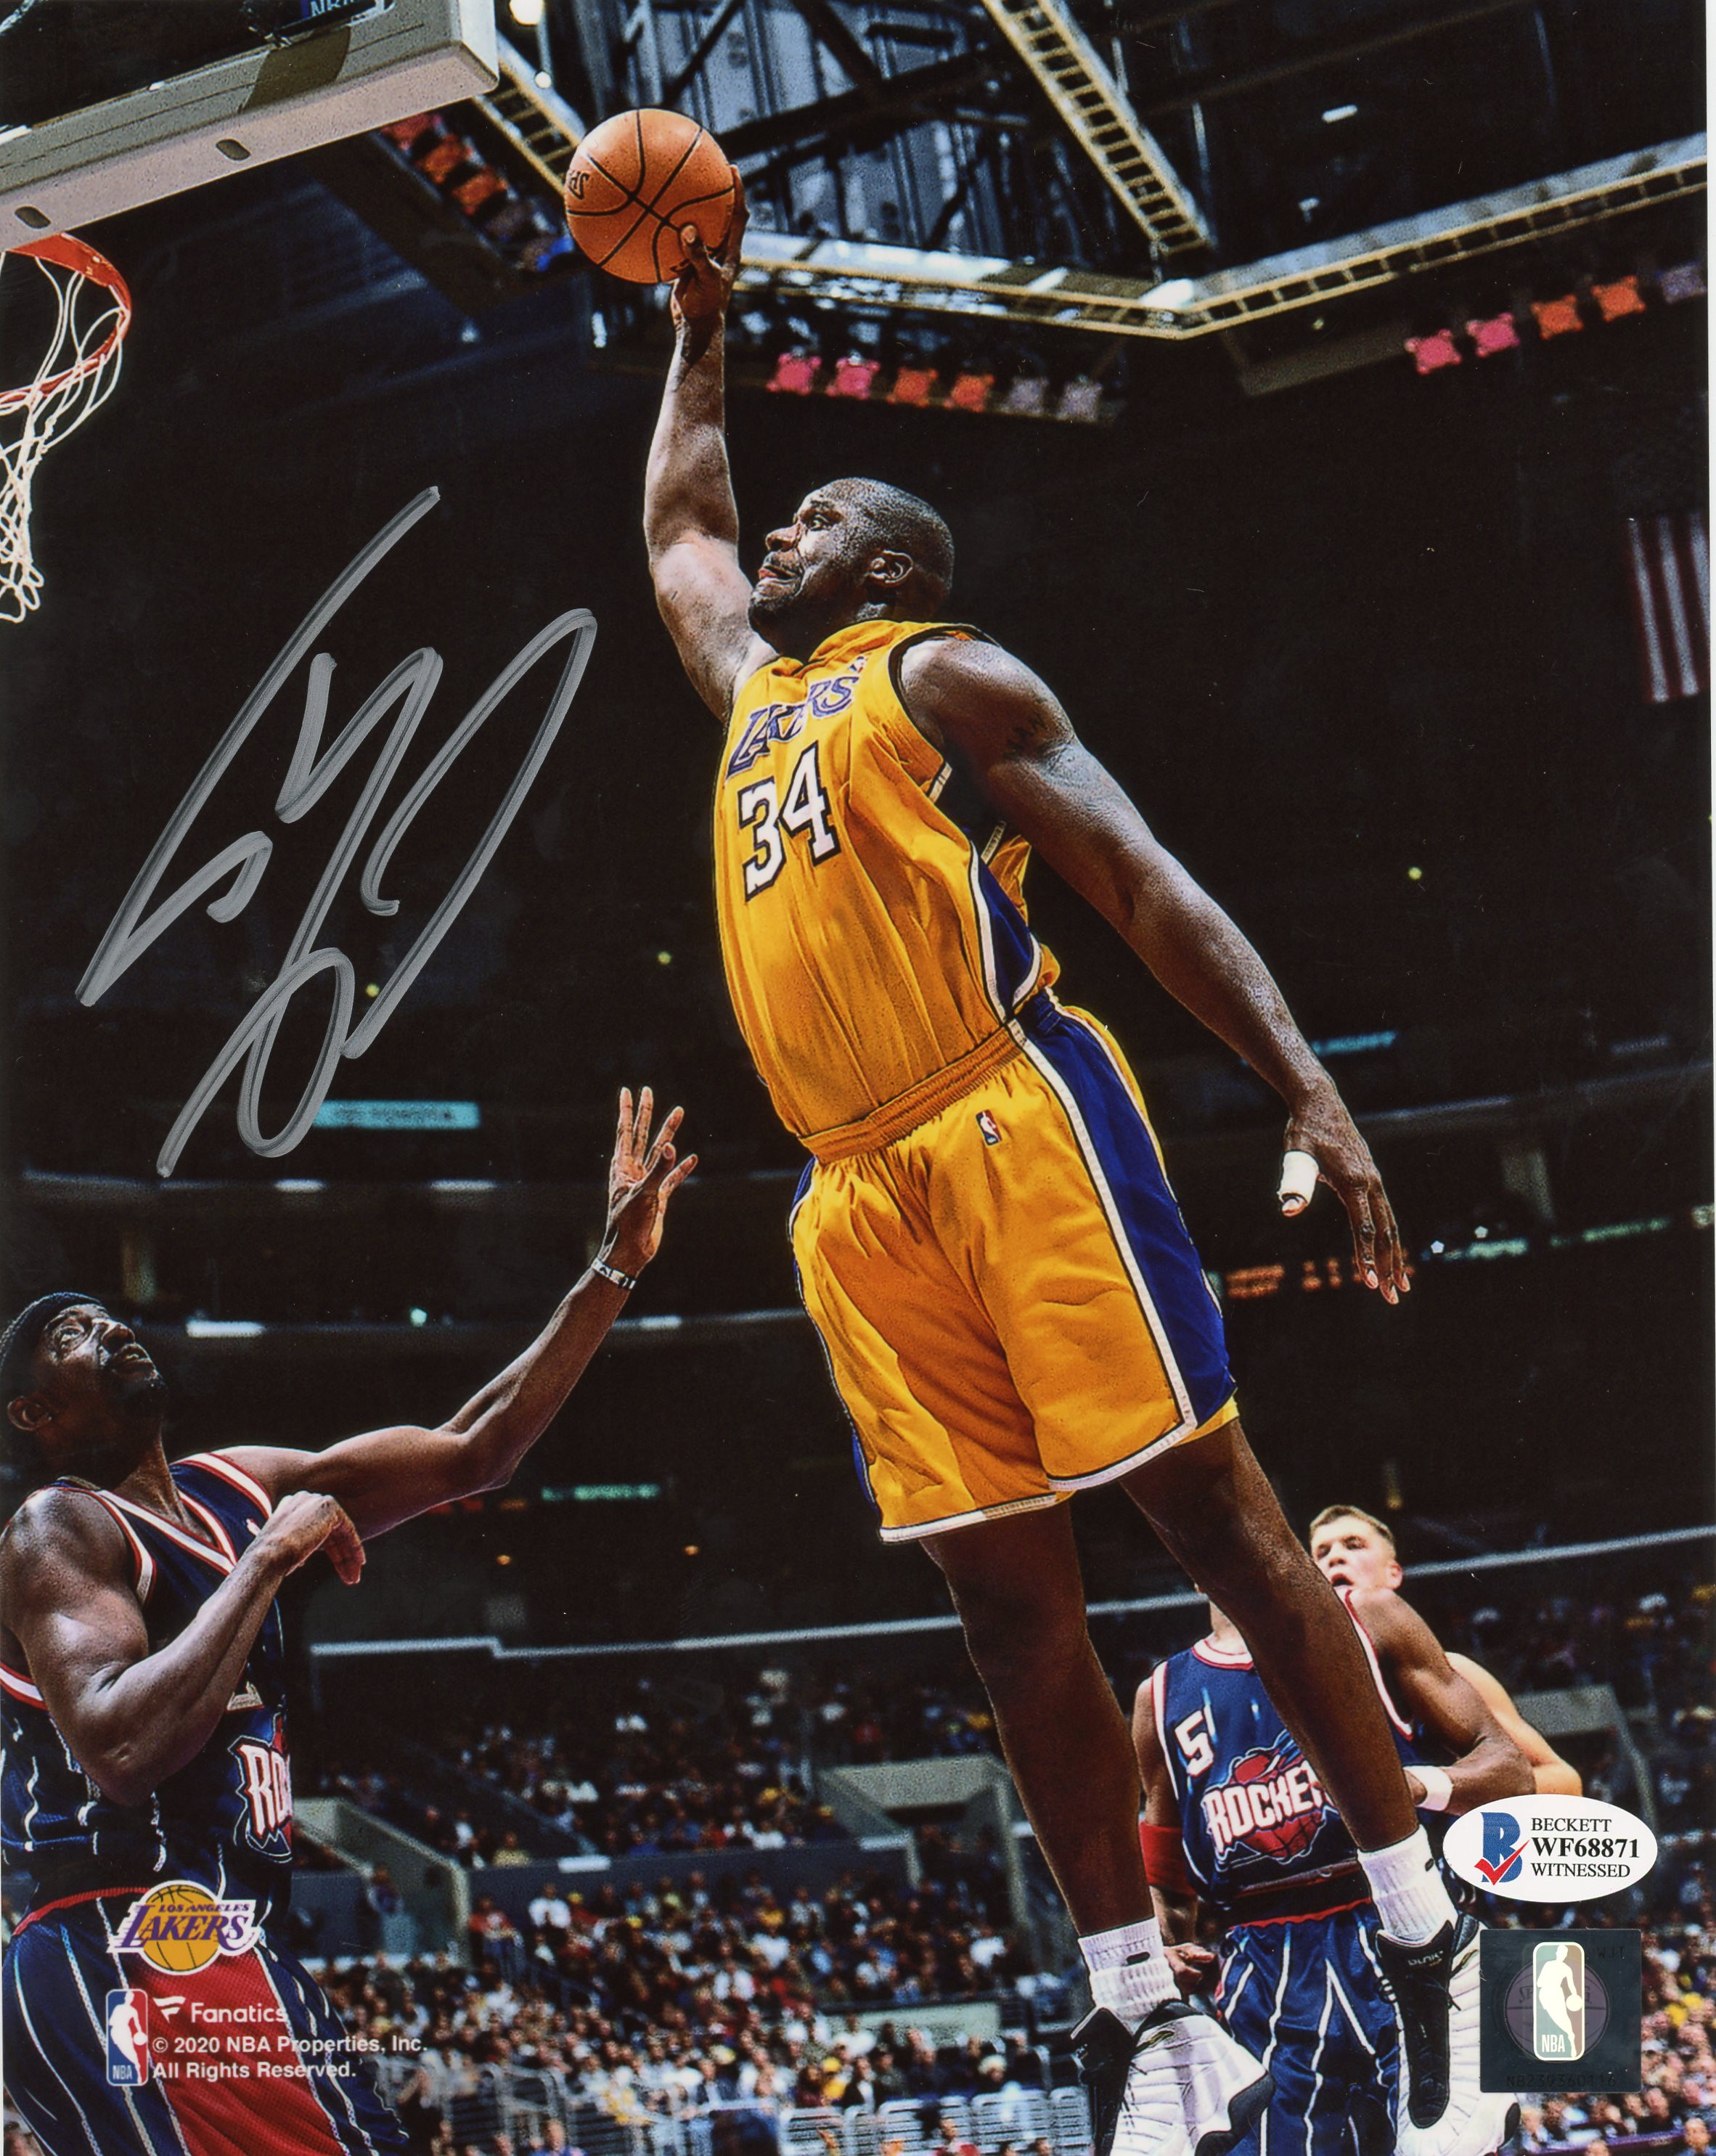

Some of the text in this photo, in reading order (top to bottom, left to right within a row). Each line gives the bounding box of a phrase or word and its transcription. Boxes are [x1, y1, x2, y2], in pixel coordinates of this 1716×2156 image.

[738, 740, 841, 903] 34
[1174, 1710, 1214, 1778] 5
[1531, 1818, 1612, 1832] BECKETT
[1531, 1837, 1640, 1858] WF68871
[1531, 1863, 1630, 1878] WITNESSED
[1541, 2034, 1565, 2053] NBA
